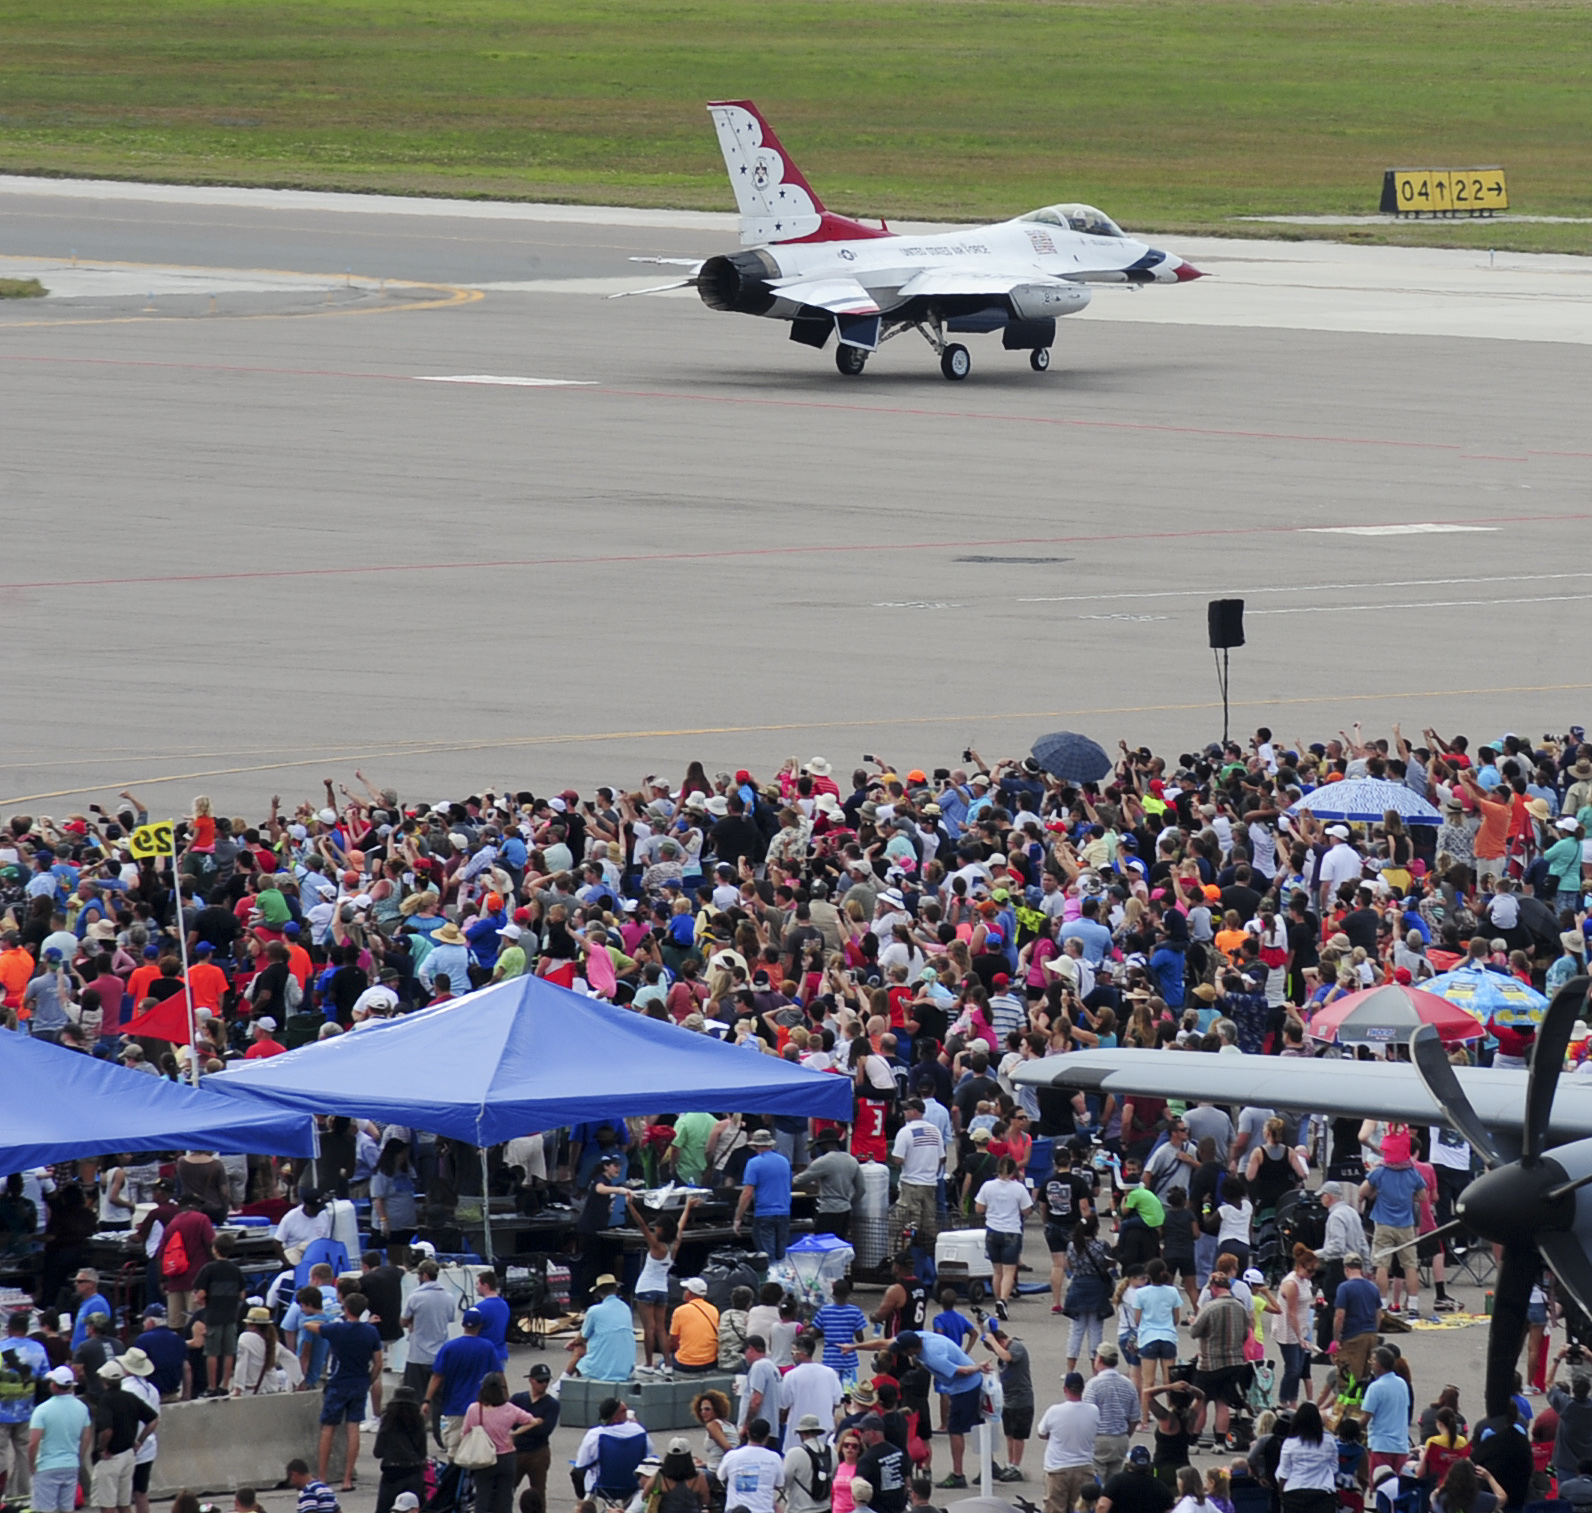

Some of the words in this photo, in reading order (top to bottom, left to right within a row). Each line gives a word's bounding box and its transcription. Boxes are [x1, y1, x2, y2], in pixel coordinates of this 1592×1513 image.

[1401, 179, 1430, 202] 04
[1455, 179, 1485, 201] 22
[871, 1109, 883, 1136] 3
[914, 1301, 925, 1324] 6
